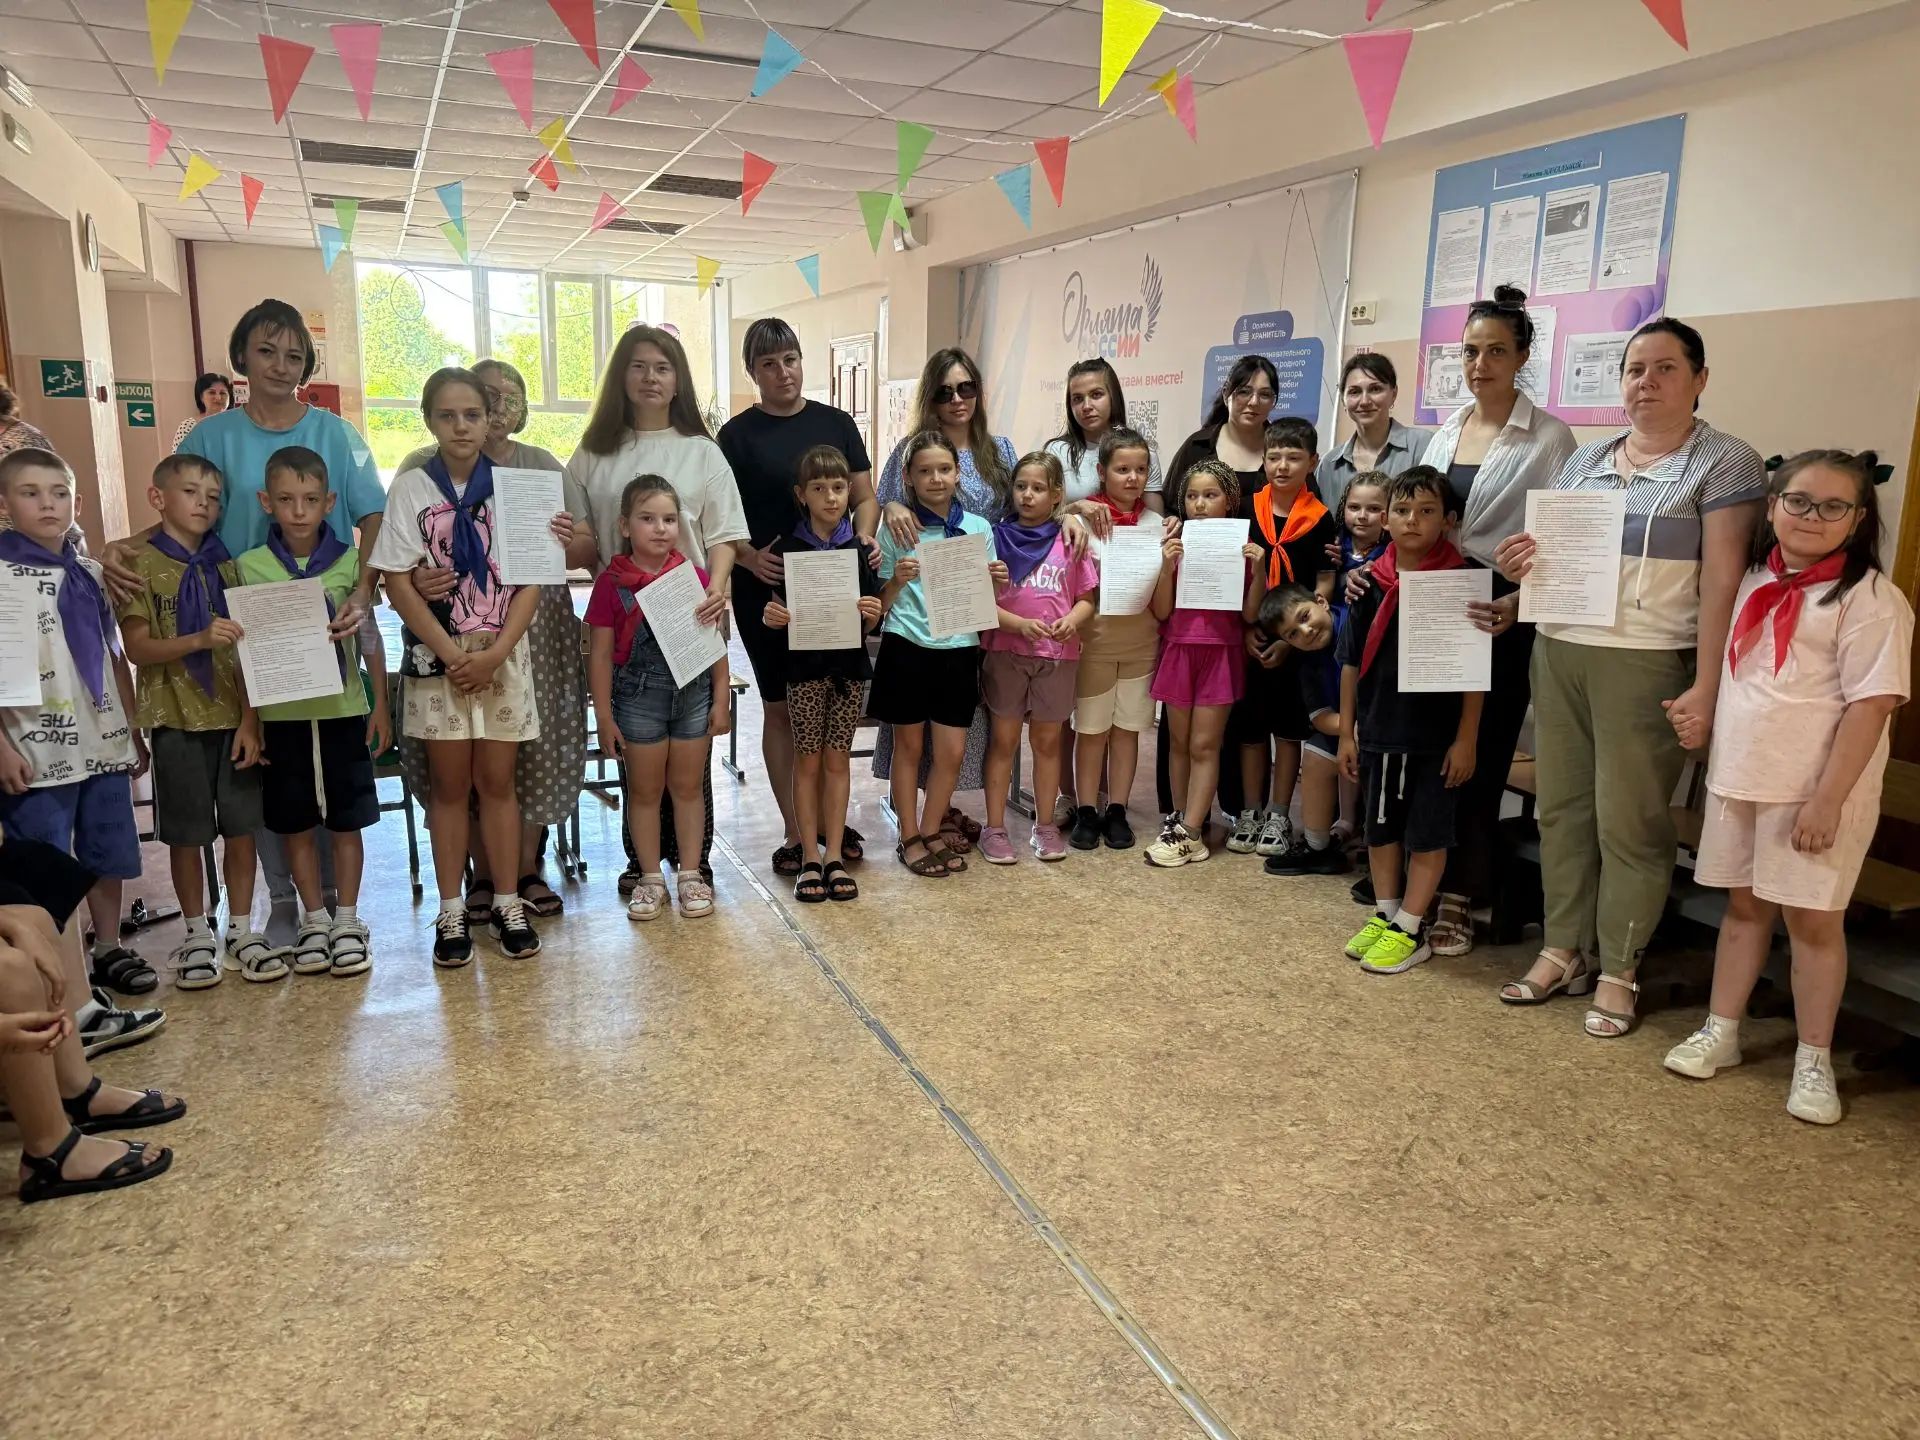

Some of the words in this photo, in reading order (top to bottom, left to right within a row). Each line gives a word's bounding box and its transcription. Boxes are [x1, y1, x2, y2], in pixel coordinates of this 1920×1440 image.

[1062, 271, 1144, 347] Орлята
[1251, 330, 1287, 341] ХРАНИТЕЛЬ
[1145, 371, 1184, 386] вместе!
[1014, 563, 1066, 593] AGIC
[38, 713, 76, 728] THE
[19, 730, 79, 746] ENJOY
[42, 764, 74, 779] RULES
